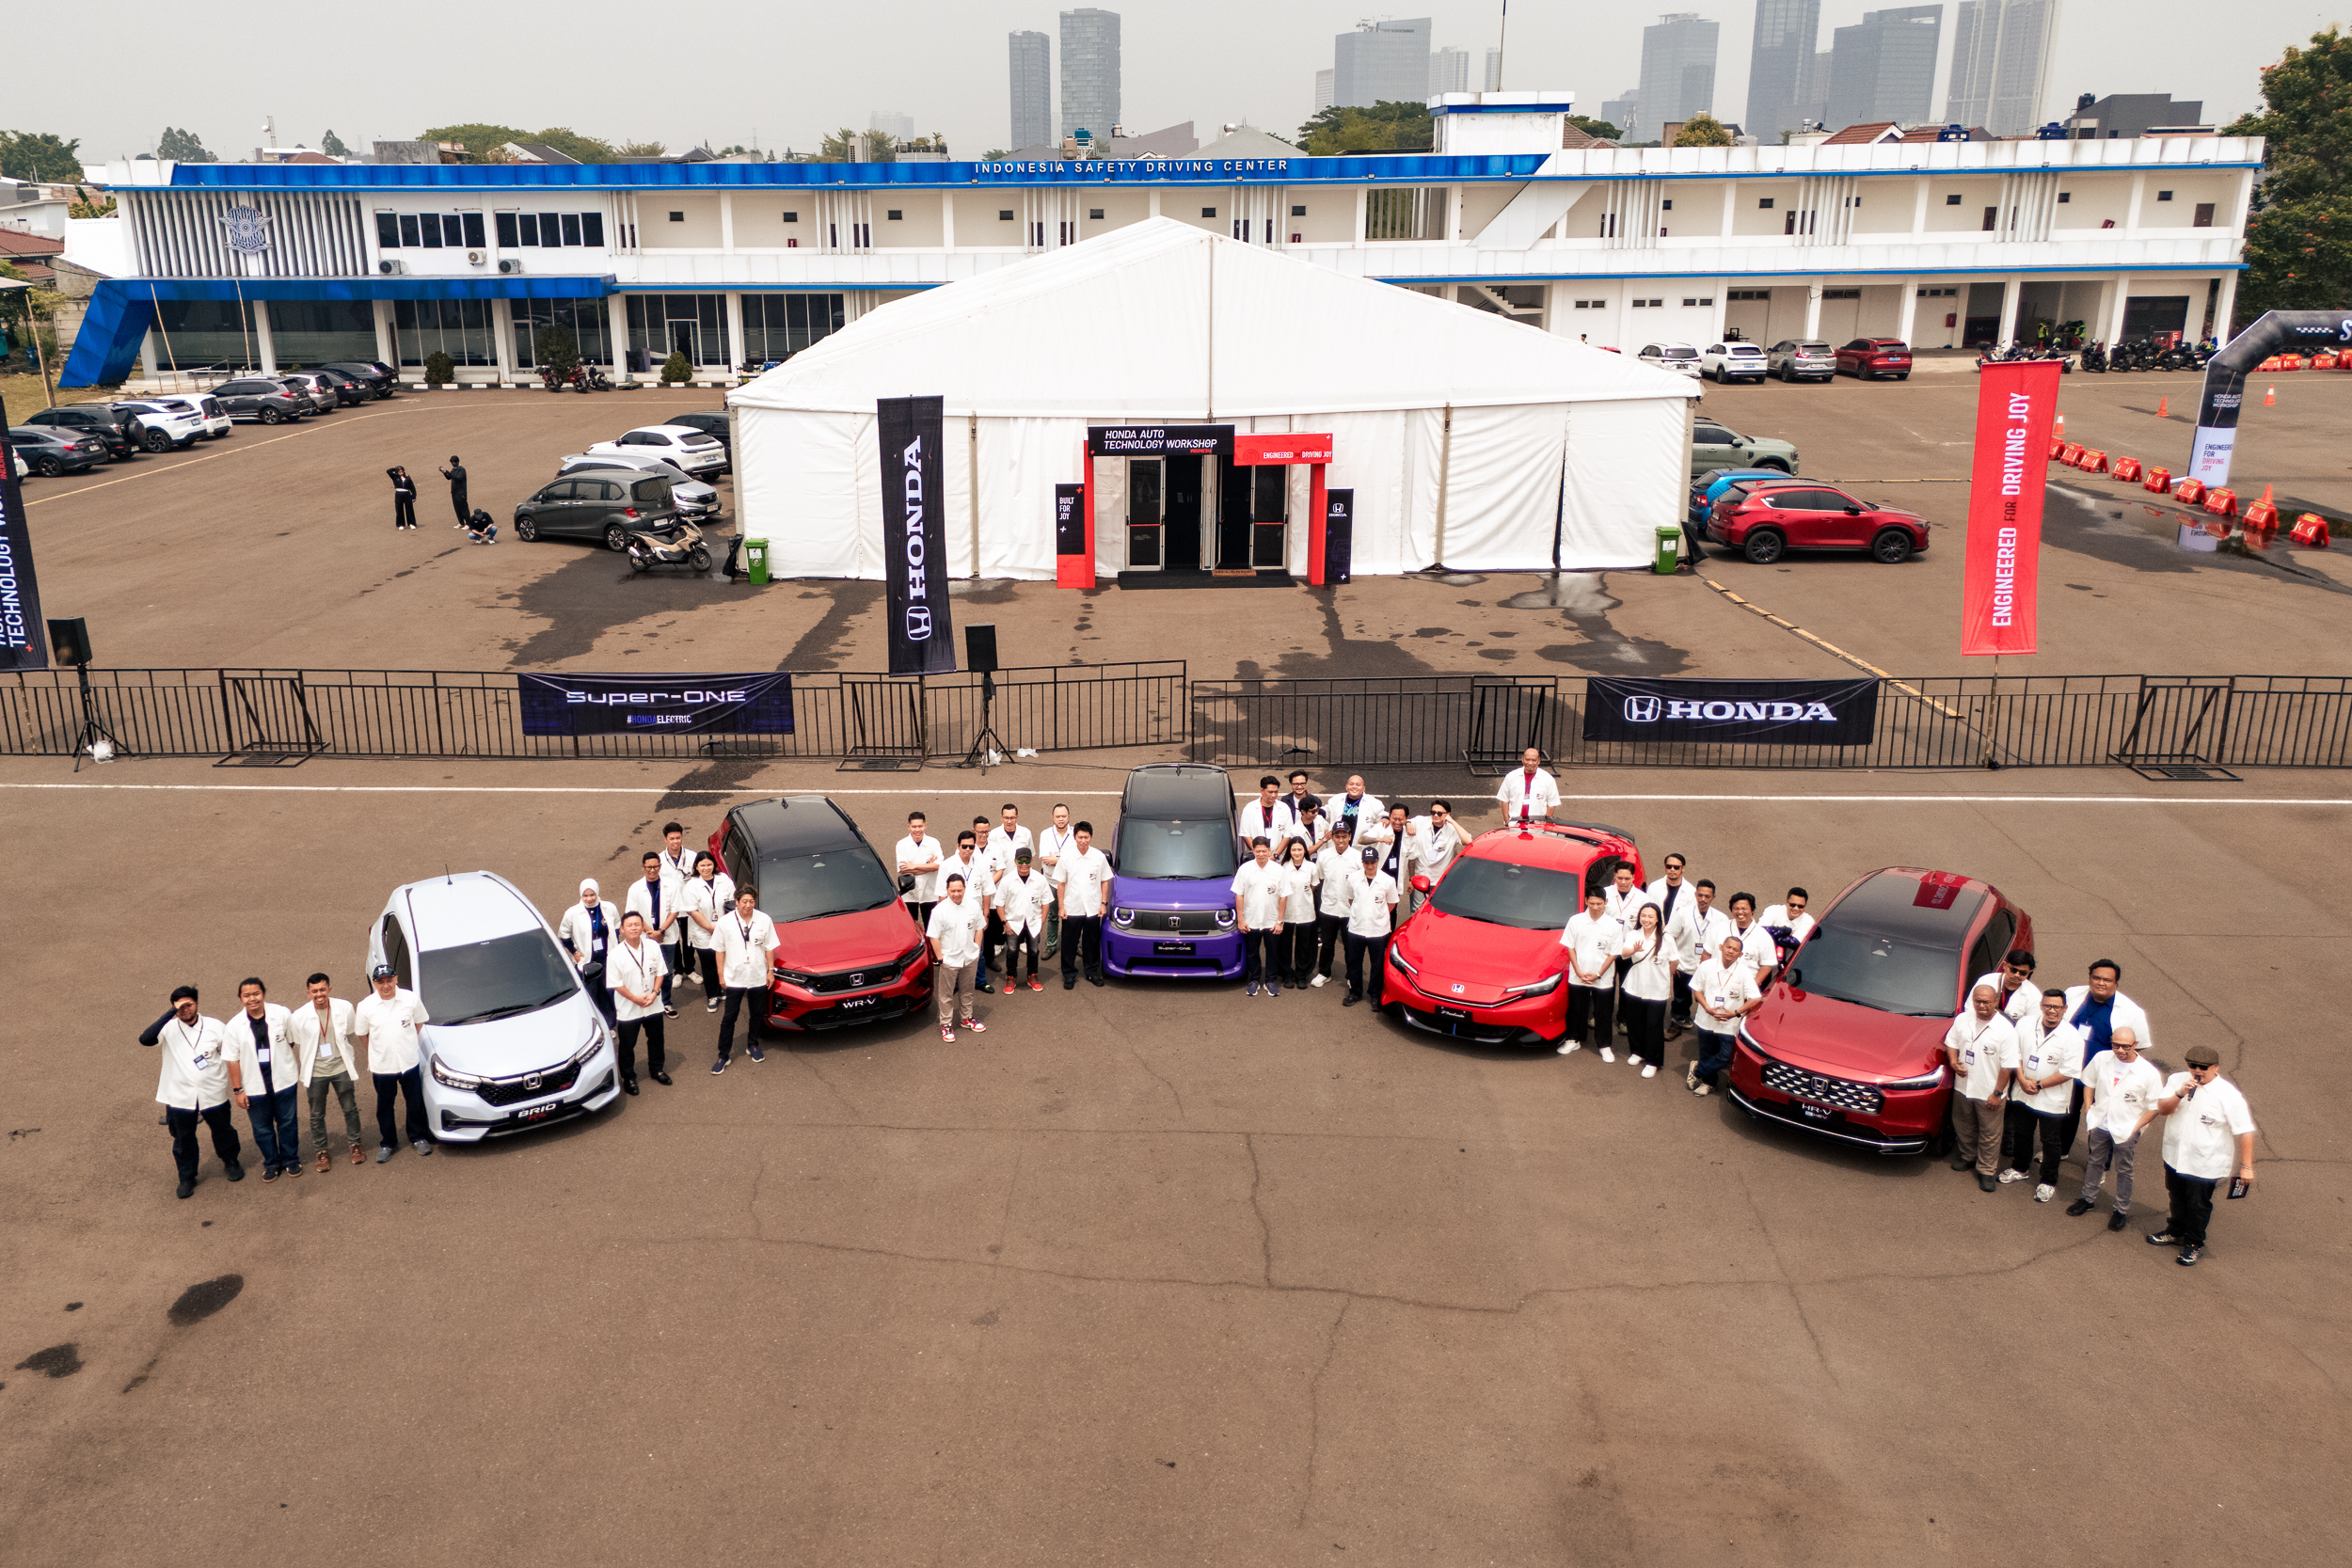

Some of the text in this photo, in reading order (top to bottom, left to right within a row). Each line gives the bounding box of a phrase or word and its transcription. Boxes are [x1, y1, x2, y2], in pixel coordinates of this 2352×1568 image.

[975, 160, 1287, 173] INDONESIA SAFETY DRIVING CENTER
[1104, 429, 1165, 439] HONDA AUTO
[1104, 438, 1217, 450] TECHNOLOGY WORKSHOP
[1059, 504, 1071, 513] FOR
[1992, 392, 2030, 626] ENGINEERED FOR DRIVING JOY
[903, 436, 927, 600] HONDA
[1666, 700, 1837, 721] HONDA
[627, 714, 691, 724] #HONDAELECTRIC
[843, 997, 877, 1008] WR-V
[518, 1102, 557, 1118] BRIO
[1802, 1101, 1832, 1116] HR-V
